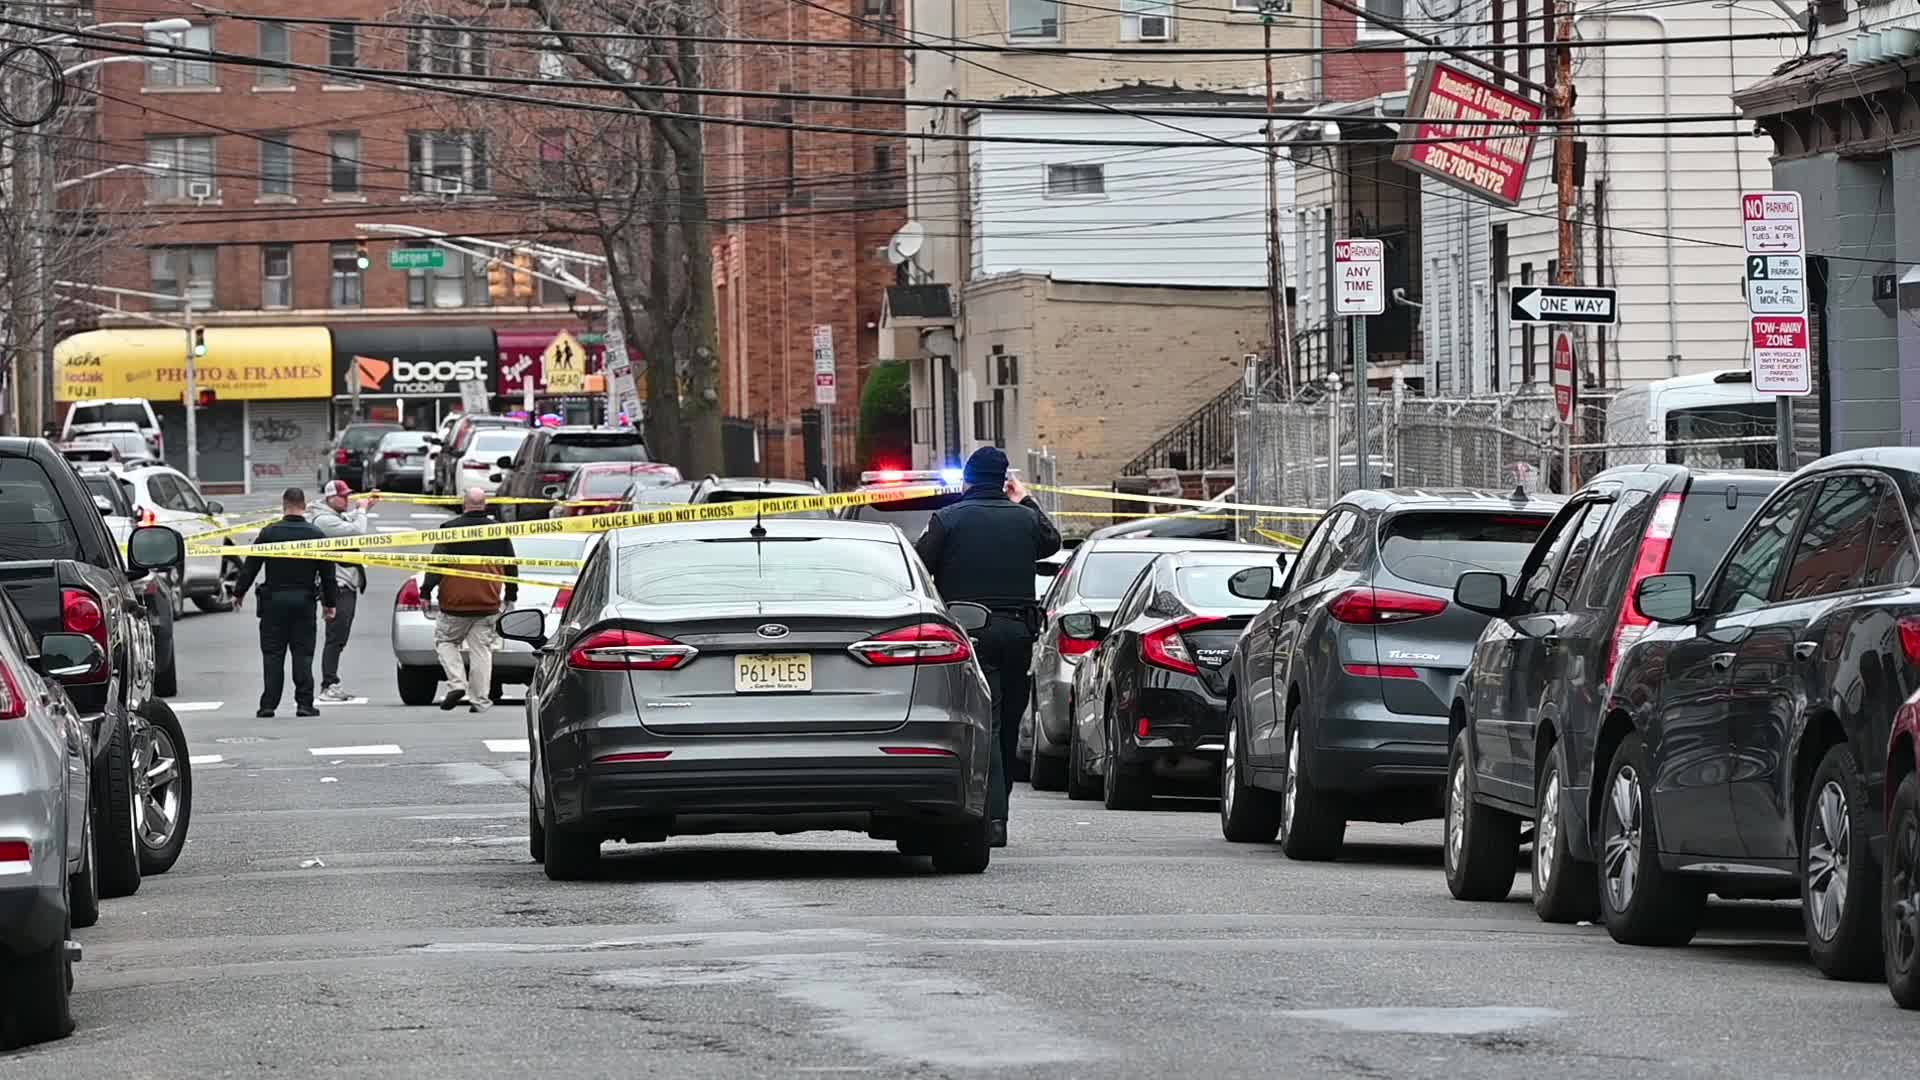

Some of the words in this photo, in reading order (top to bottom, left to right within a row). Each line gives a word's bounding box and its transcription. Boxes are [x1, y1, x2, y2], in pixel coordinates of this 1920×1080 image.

[1438, 71, 1475, 102] Domestic
[1482, 89, 1512, 120] Foreign
[1456, 106, 1488, 145] AUTO
[1425, 146, 1505, 193] 201-780-5172
[1745, 199, 1763, 218] NO
[1766, 202, 1794, 213] PARKING
[391, 251, 429, 266] Bergen
[1336, 245, 1350, 258] NO
[1351, 246, 1380, 256] PARKING
[1346, 267, 1370, 277] ANY
[1753, 258, 1764, 278] 2
[1770, 268, 1799, 276] PARKING
[1344, 281, 1373, 291] TIME
[1540, 298, 1569, 311] ONE
[1575, 299, 1603, 312] WAY
[1754, 322, 1803, 334] TOW-AWAY
[1766, 334, 1793, 346] ZONE
[65, 356, 101, 367] AGFA
[392, 356, 488, 382] boost
[227, 367, 238, 379] &
[244, 364, 322, 380] FRAMES
[393, 382, 445, 392] mobile
[550, 374, 579, 386] AHEAD
[68, 385, 96, 396] FUJI
[762, 500, 800, 512] POLICE
[802, 498, 825, 509] LINE
[829, 496, 843, 505] DO
[847, 493, 867, 503] NOT
[871, 490, 904, 502] CROSS
[592, 517, 629, 528] POLICE
[632, 514, 655, 525] LINE
[658, 511, 673, 522] DO
[676, 509, 696, 521] NOT
[700, 505, 734, 519] CROSS
[421, 530, 458, 542] POLICE
[462, 527, 484, 538] LINE
[488, 526, 502, 537] DO
[505, 523, 525, 535] NOT
[529, 521, 563, 533] CROSS
[291, 542, 313, 550] LINE
[317, 539, 332, 549] DO
[335, 537, 354, 547] NOT
[359, 534, 393, 545] CROSS
